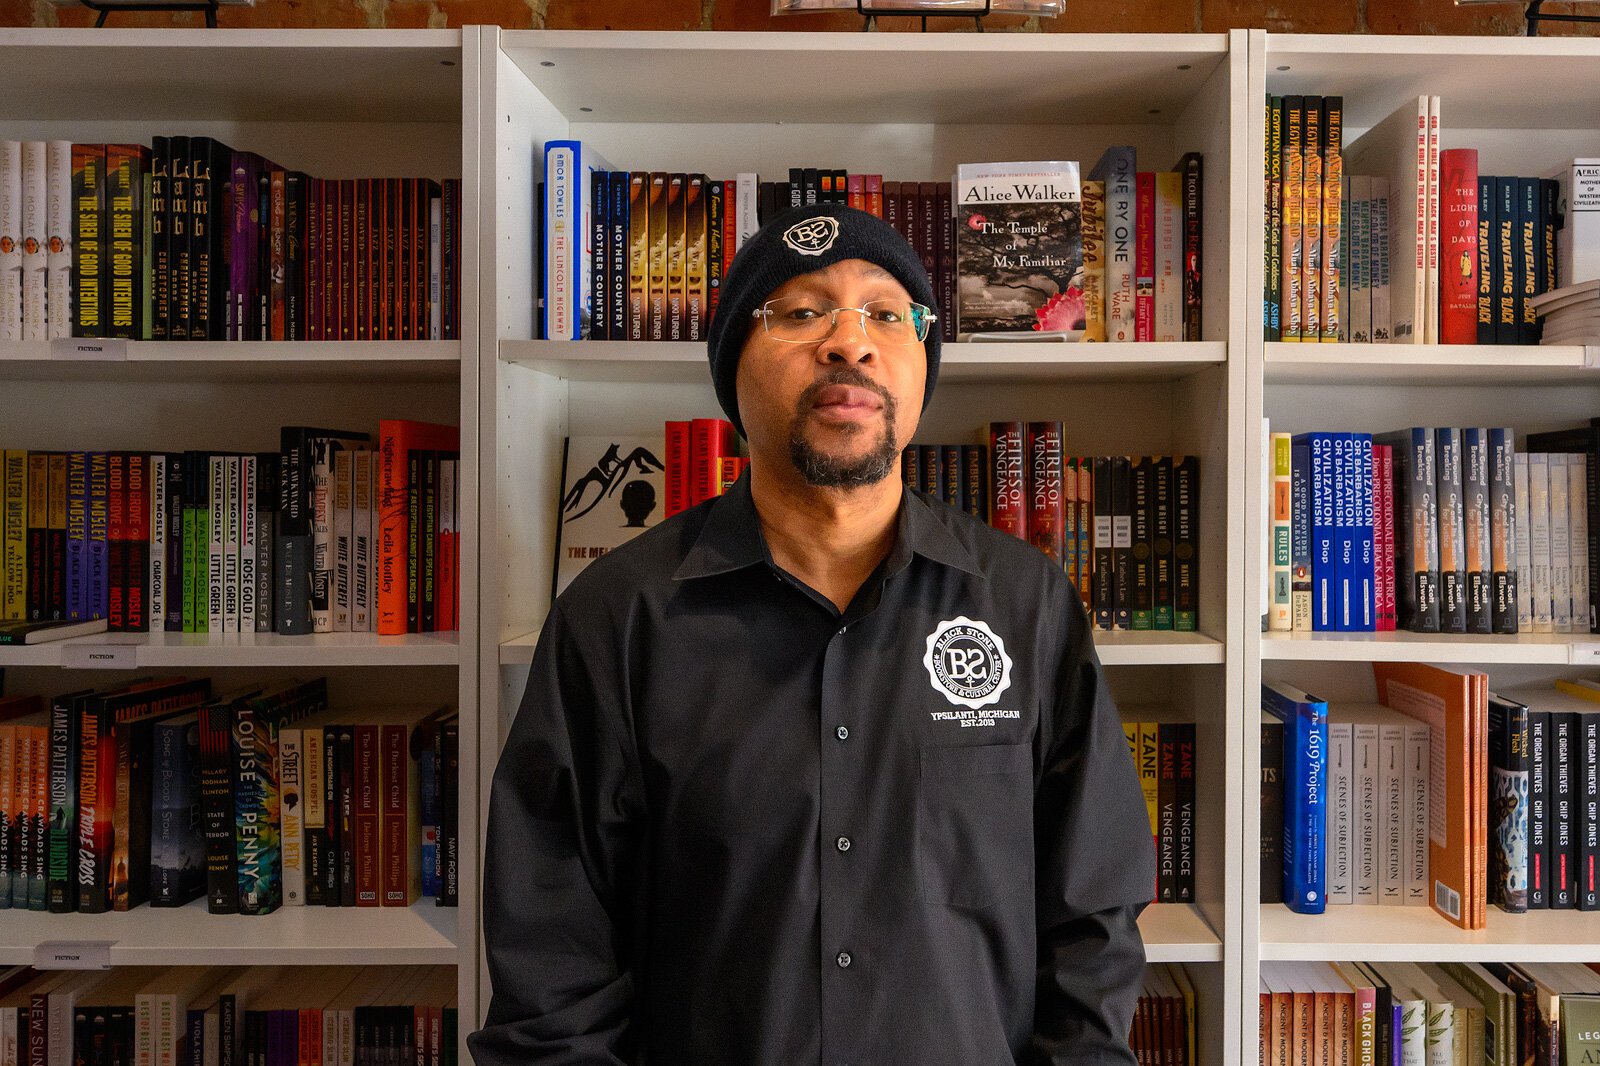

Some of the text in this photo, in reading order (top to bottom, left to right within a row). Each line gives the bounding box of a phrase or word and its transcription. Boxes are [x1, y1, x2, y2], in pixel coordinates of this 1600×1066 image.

[1272, 109, 1280, 151] EGYPTIAN
[1272, 153, 1280, 179] YOGA
[152, 158, 167, 234] Lamb
[172, 158, 189, 235] Lamb
[193, 160, 210, 236] Lamb
[964, 184, 1075, 202] Alice Walker
[1272, 183, 1280, 208] Postures
[978, 222, 1048, 235] The Temple
[1005, 241, 1017, 250] of
[1082, 186, 1104, 263] Jubilee
[1115, 227, 1128, 262] ONE
[1352, 201, 1360, 291] THE COLOR OF MONEY
[1361, 201, 1369, 288] MEHRSA BARADARAN
[80, 197, 98, 326] THE SIREN OF GOOD INTENTIONS
[993, 255, 1066, 269] My Familiar
[1271, 258, 1279, 290] Goddesses
[1501, 221, 1514, 325] TRAVELING BLACK
[1112, 291, 1120, 320] WARE
[1122, 274, 1130, 302] RUTH
[1270, 301, 1279, 330] ASHBY
[1046, 439, 1060, 487] FIRES
[1314, 439, 1321, 455] OR
[1495, 446, 1503, 481] Breaking
[129, 456, 141, 524] BLOOD GROVE
[290, 448, 298, 518] THE AWKWARD
[382, 436, 394, 508] Nightcrawling
[970, 450, 979, 495] EMBERS
[1035, 435, 1046, 510] VENGEANCE
[1322, 439, 1332, 526] CIVILIZATION
[90, 455, 106, 541] WALTER MOSLEY
[1047, 489, 1058, 507] OF
[198, 520, 206, 615] WALTER MOSLEY
[260, 522, 268, 617] WALTER MOSLEY
[381, 528, 394, 593] Leila Mottley
[568, 547, 587, 558] THE
[1279, 531, 1288, 561] RULES
[1321, 539, 1329, 564] Diop
[153, 560, 161, 614] CHARCOAL JOE
[226, 554, 236, 614] LITTLE GREEN
[243, 559, 253, 613] ROSE GOLD
[357, 536, 367, 608] WHITE BUTTERFLY
[936, 627, 995, 650] BLACK STONE
[979, 710, 1020, 718] MICHIGAN
[52, 705, 67, 805] JAMES PATTERSON
[238, 711, 255, 782] LOUISE
[391, 732, 399, 749] The
[1143, 733, 1156, 778] ZANE
[1181, 742, 1191, 779] ZANE
[1512, 733, 1520, 753] Flesh
[1521, 729, 1529, 757] Wicked
[282, 752, 299, 785] STREET
[391, 751, 399, 782] Darkest
[1307, 729, 1322, 804] 1619 Project
[1533, 722, 1542, 845] THE ORGAN THIEVES CHIP JONES
[79, 712, 97, 885] JAMES PATTERSON TRIPLE CROSS
[49, 829, 68, 881] BLINDSIDE
[242, 812, 259, 878] PENNY
[284, 815, 299, 871] ANN PETRY
[1181, 803, 1190, 876] VENGEANCE
[32, 998, 44, 1031] NEW
[1362, 1002, 1371, 1037] BLACK
